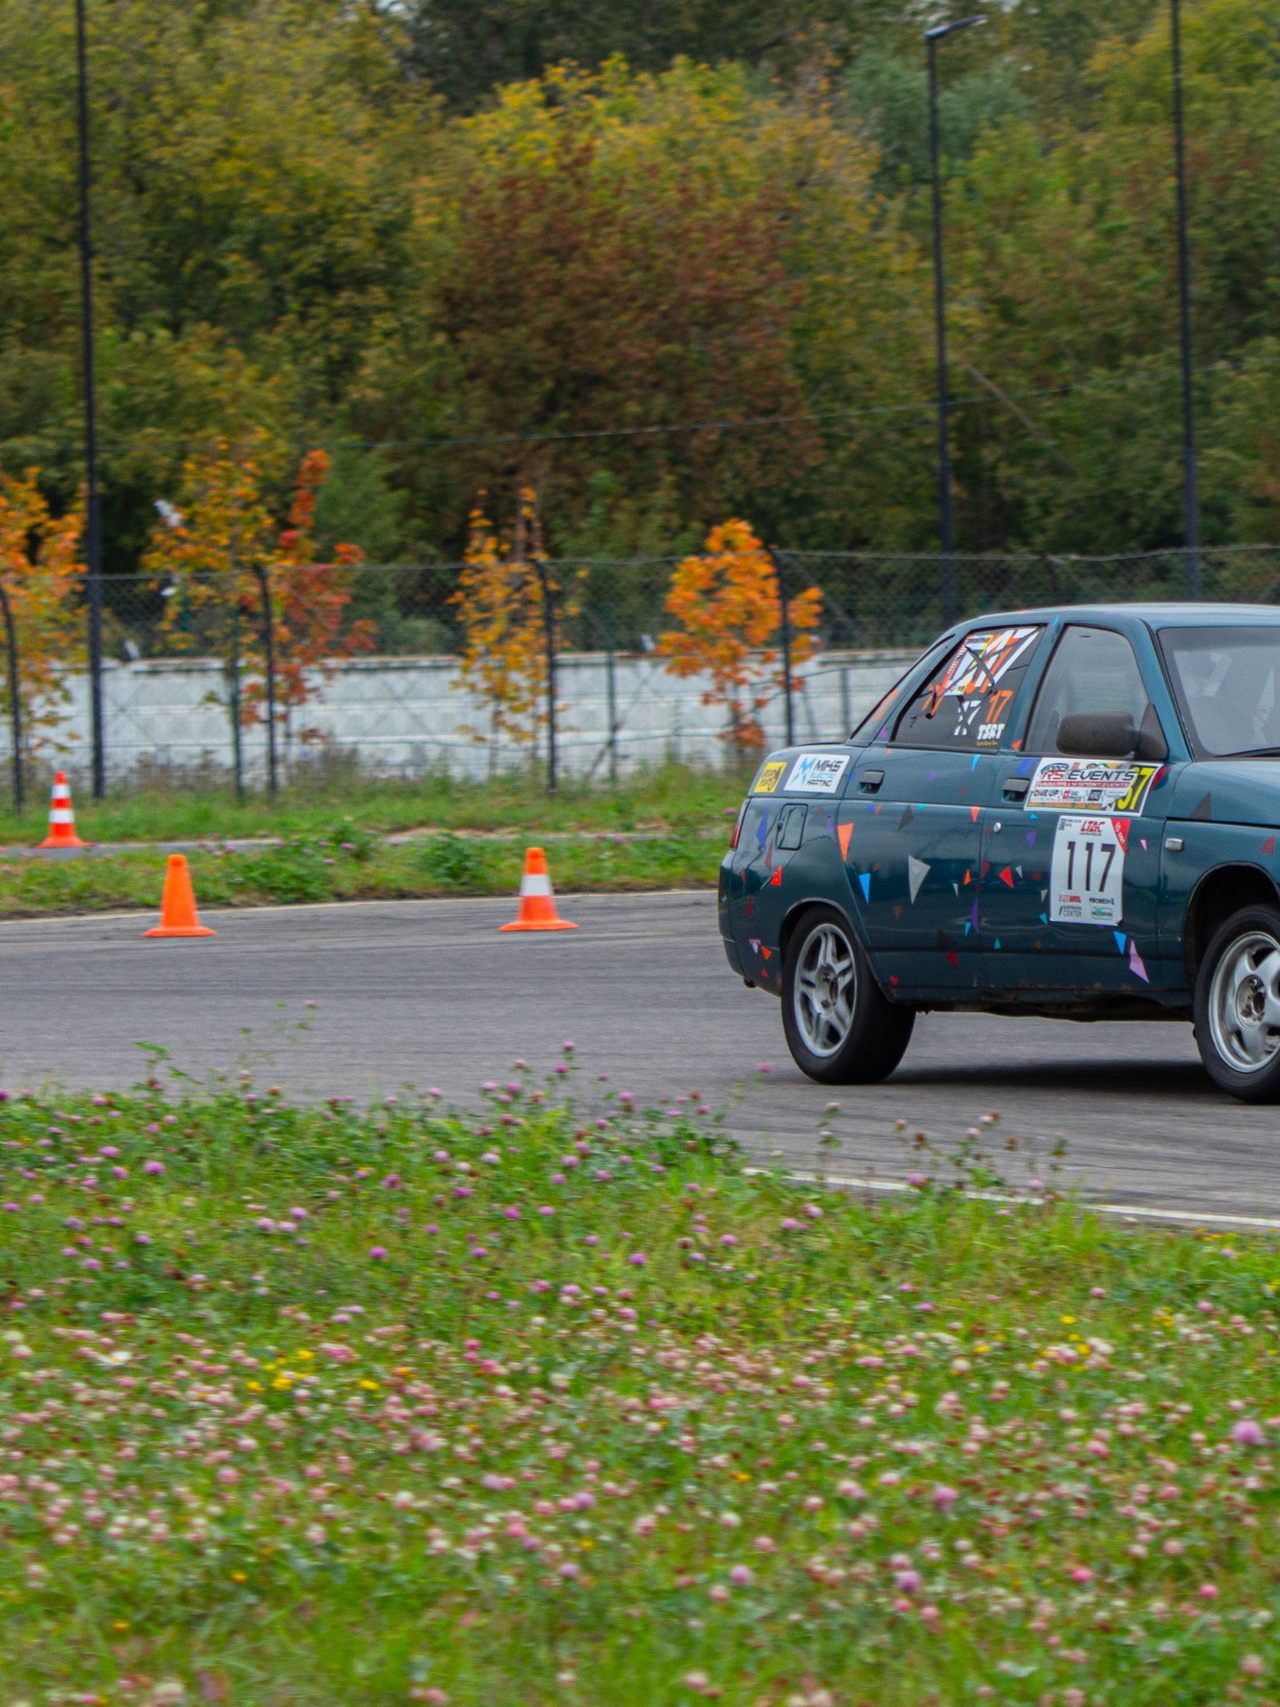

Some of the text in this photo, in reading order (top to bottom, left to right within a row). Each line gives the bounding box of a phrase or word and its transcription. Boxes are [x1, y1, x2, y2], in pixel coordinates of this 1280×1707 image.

[985, 690, 1013, 723] 17
[976, 724, 1005, 740] TSRT
[1041, 769, 1137, 781] RS EVENTS
[1066, 841, 1117, 893] 117
[1063, 909, 1082, 918] CENTER
